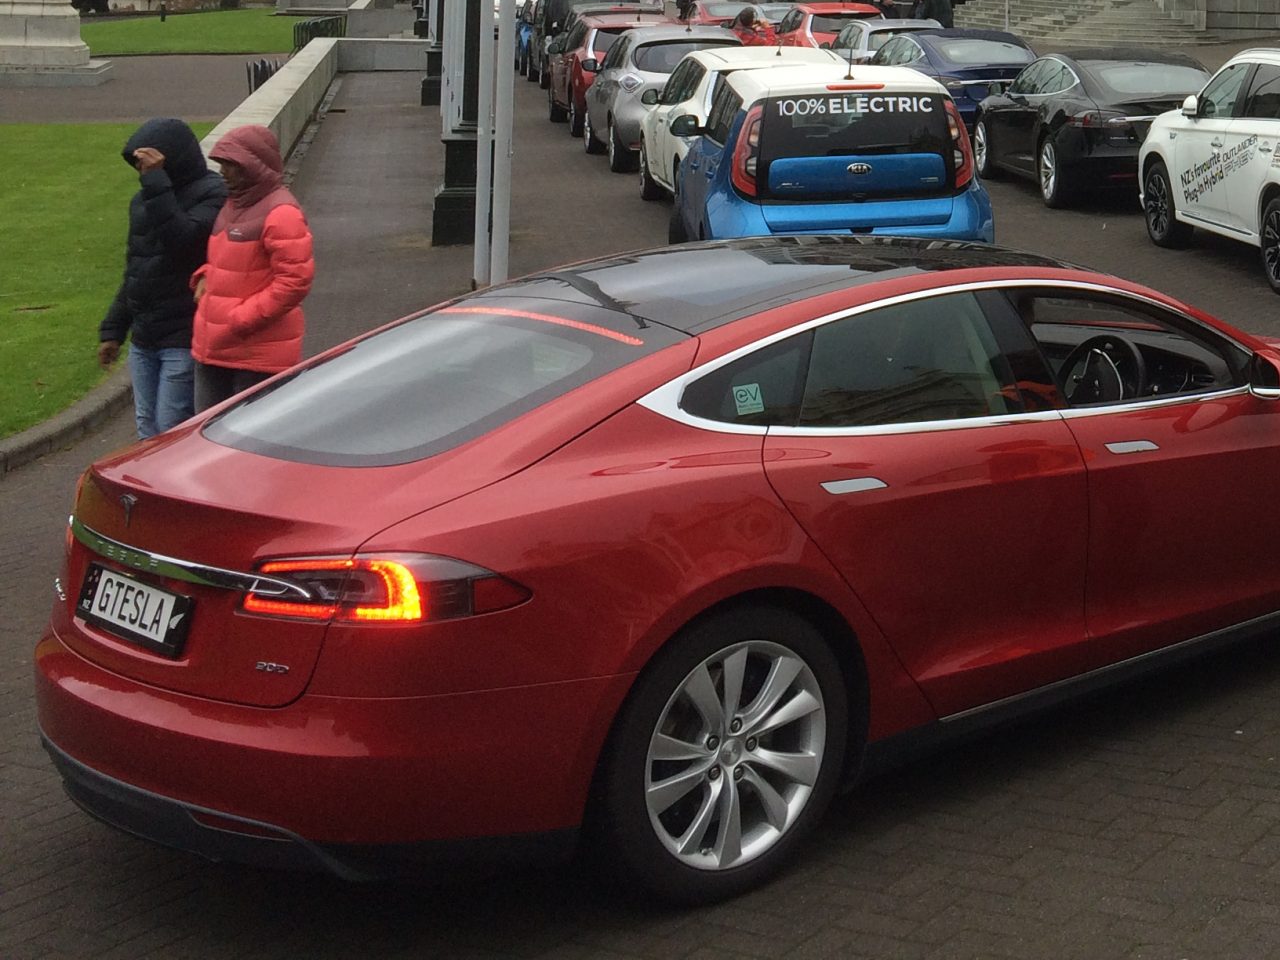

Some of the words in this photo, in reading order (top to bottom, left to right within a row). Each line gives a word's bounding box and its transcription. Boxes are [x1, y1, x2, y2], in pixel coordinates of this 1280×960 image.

[776, 98, 826, 116] 100%
[828, 97, 933, 114] ELECTRIC
[1222, 134, 1258, 162] OUTLANDER
[1194, 152, 1221, 178] favourite
[1203, 164, 1224, 192] Hybrid
[98, 577, 165, 635] GTESLA
